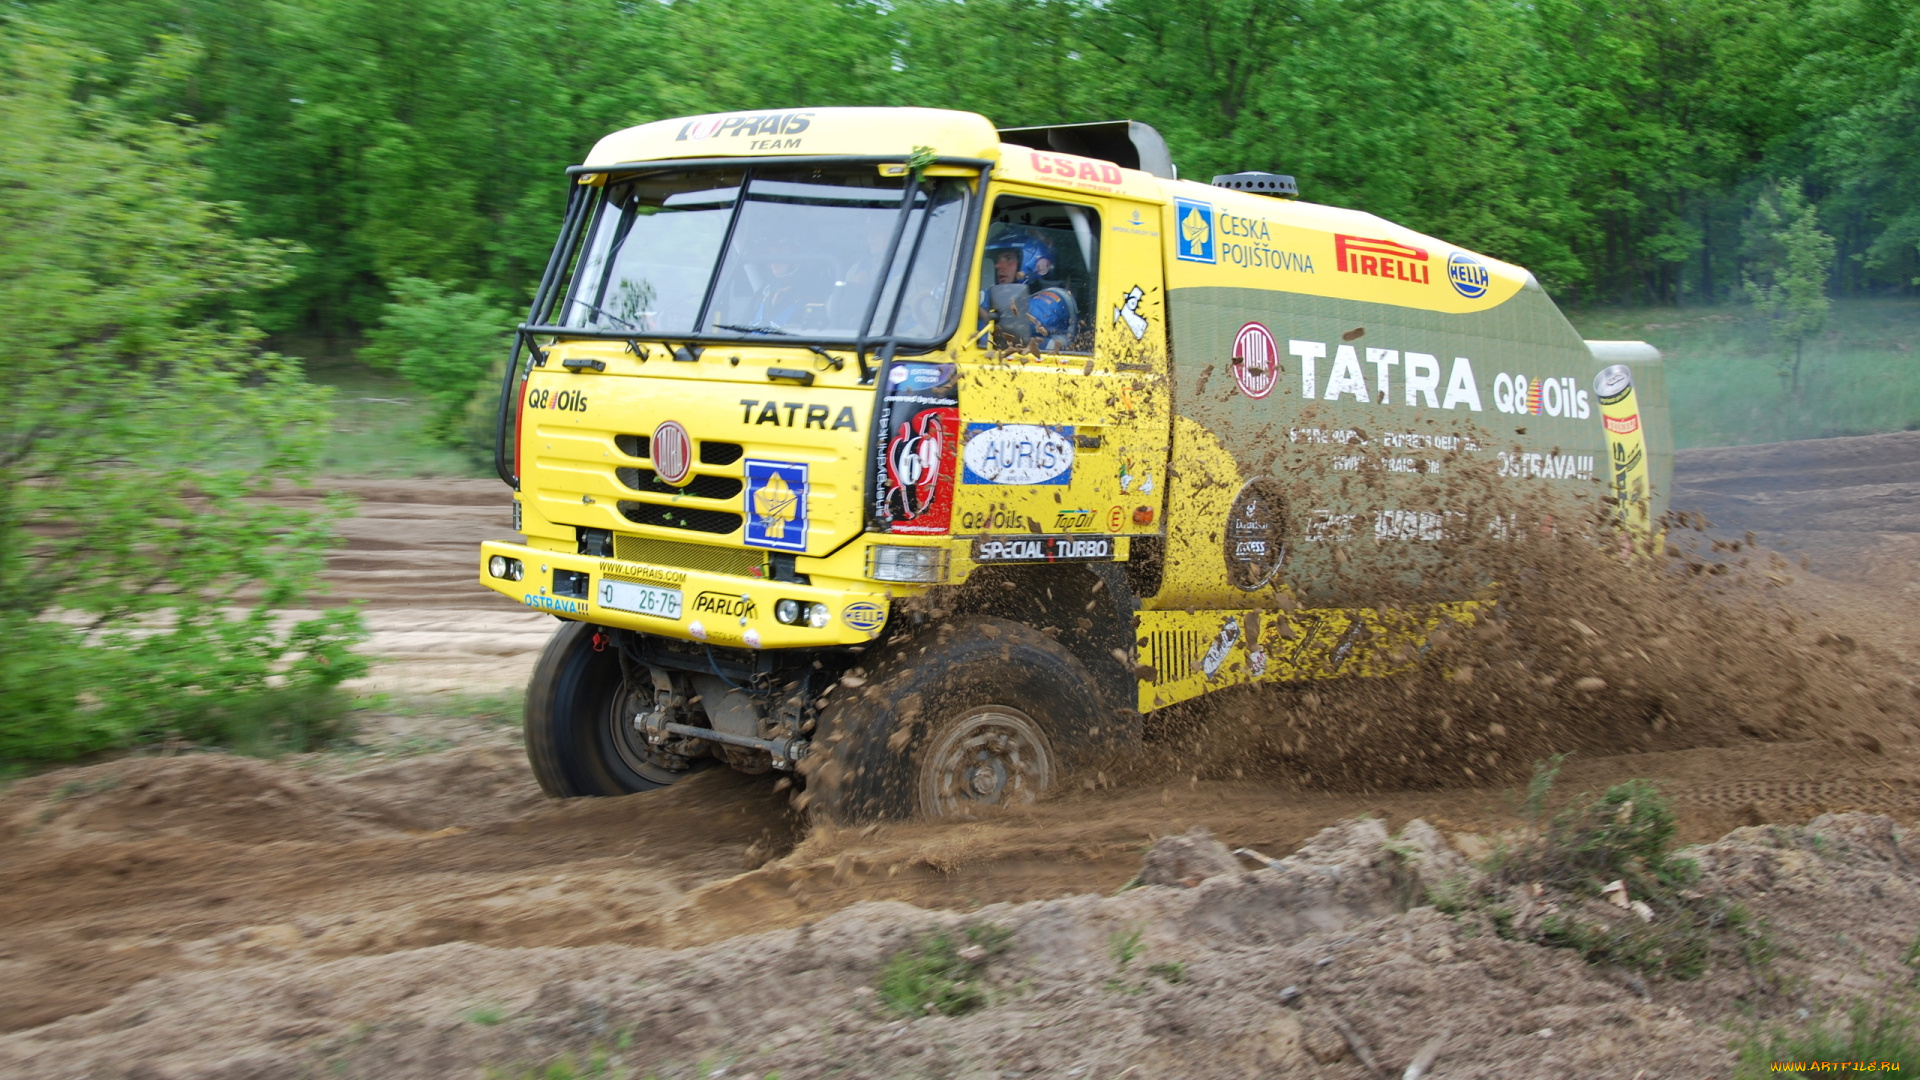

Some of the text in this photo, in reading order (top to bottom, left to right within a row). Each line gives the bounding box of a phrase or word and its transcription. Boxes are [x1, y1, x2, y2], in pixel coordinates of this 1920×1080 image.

[750, 138, 802, 150] TEAM
[1220, 208, 1271, 241] ČESKÁ
[1221, 241, 1315, 274] POJIŠŤOVNA
[1334, 233, 1429, 284] PIRELLI
[1450, 265, 1489, 287] HELLA
[1288, 339, 1482, 412] TATRA
[557, 390, 588, 412] Oils
[1543, 377, 1590, 420] Oils
[740, 399, 859, 432] TATRA
[982, 440, 1057, 469] AURIS
[979, 540, 1109, 559] SPECIAL TURBO
[600, 561, 687, 583] WWW.LOPRAIS.COM
[639, 589, 676, 614] 26-76
[696, 596, 756, 619] PARLOK
[844, 610, 886, 623] HELLA
